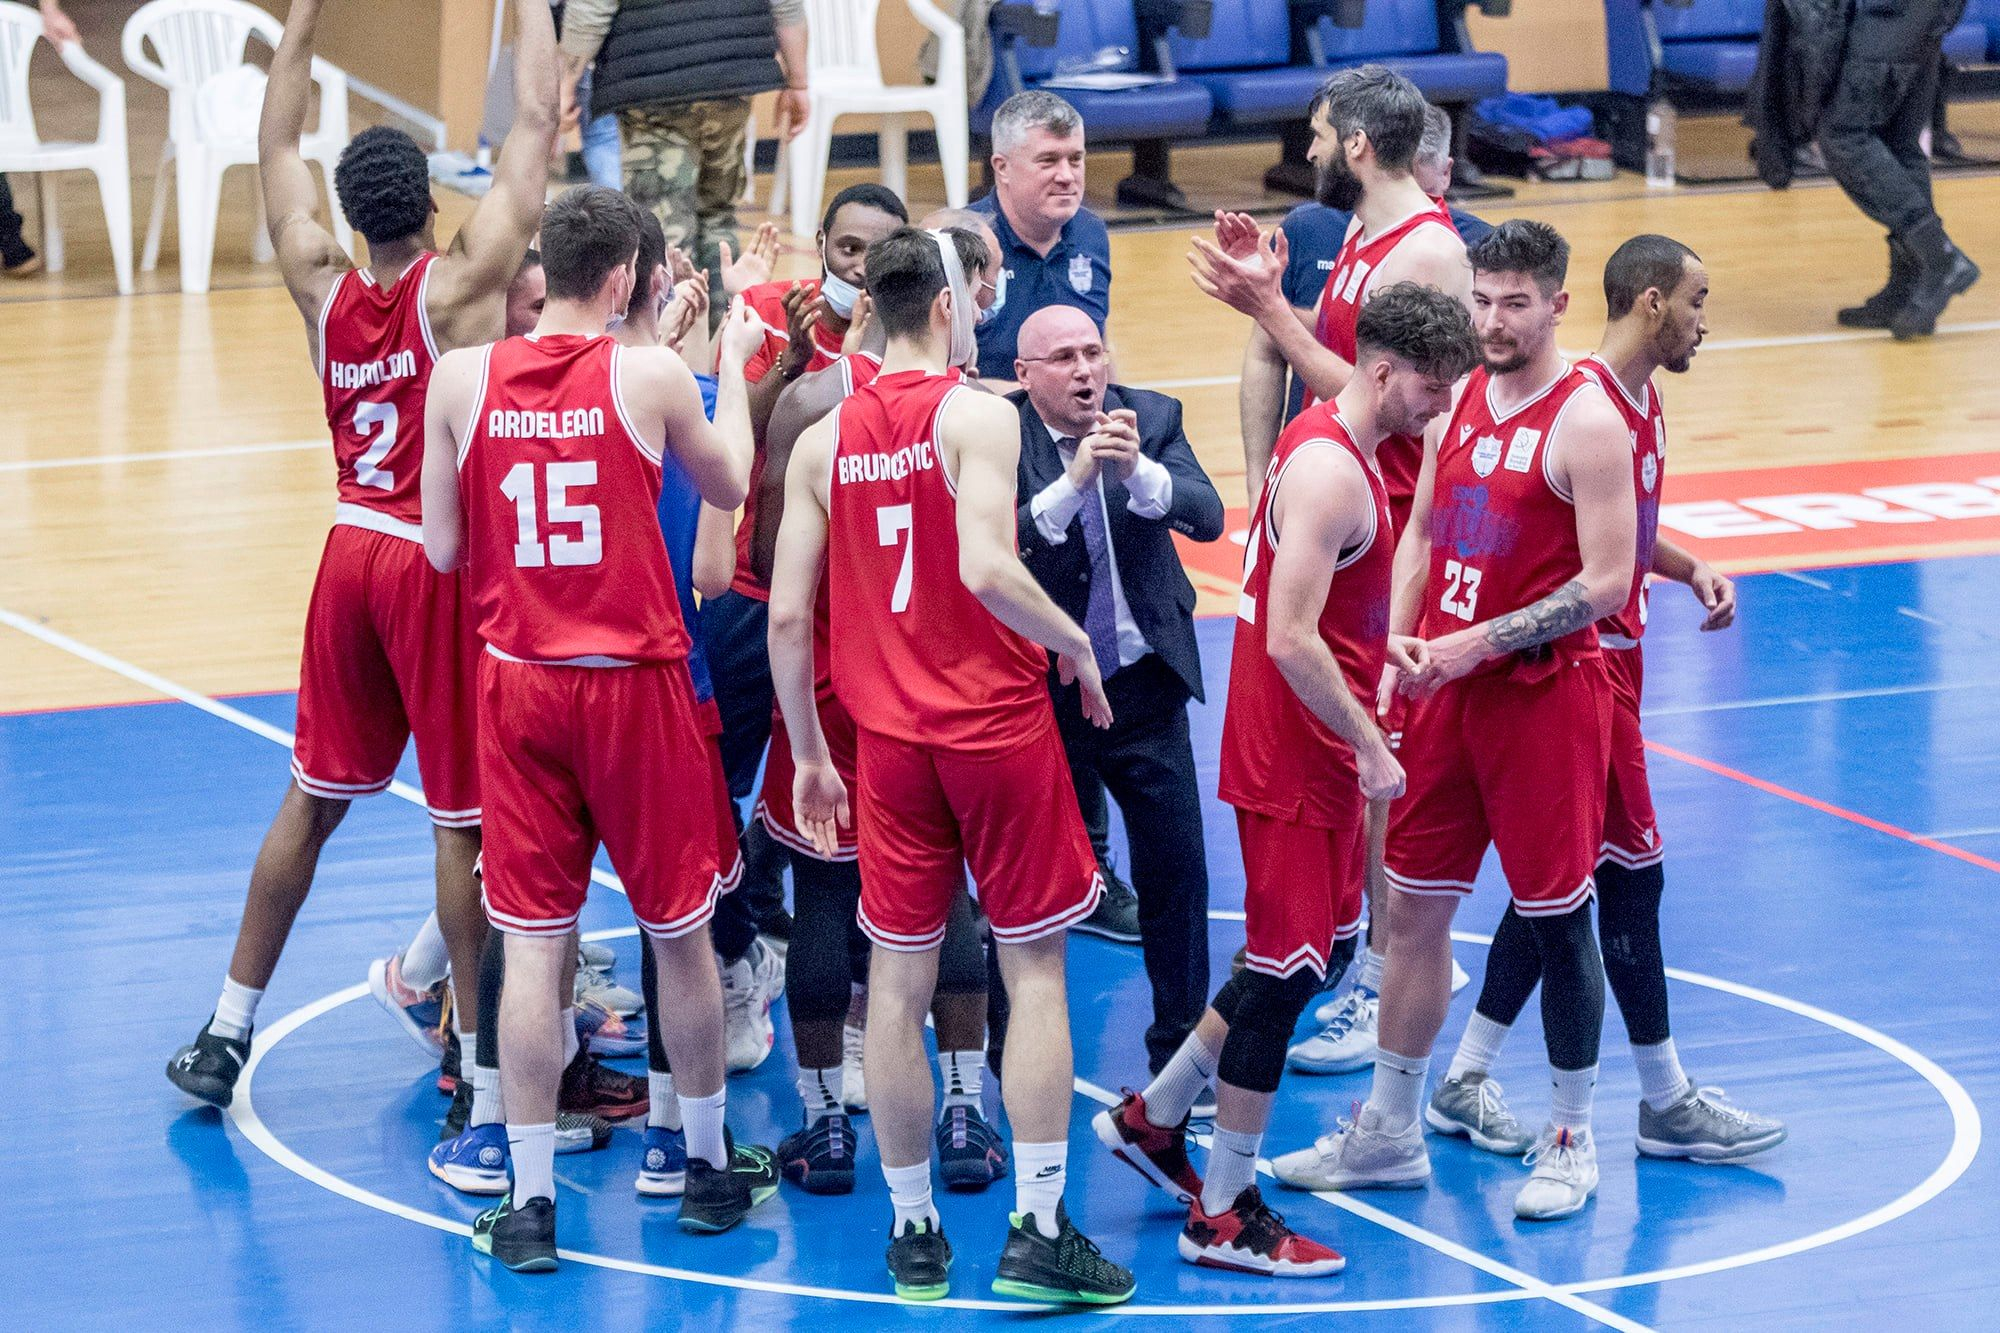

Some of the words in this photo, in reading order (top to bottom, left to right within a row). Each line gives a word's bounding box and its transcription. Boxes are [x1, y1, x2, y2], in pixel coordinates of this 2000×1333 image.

[353, 401, 398, 491] 2
[489, 407, 604, 438] ARDELEAN
[500, 461, 602, 567] 15
[1657, 475, 2000, 539] ERB
[876, 503, 913, 613] 7
[1440, 559, 1482, 622] 23
